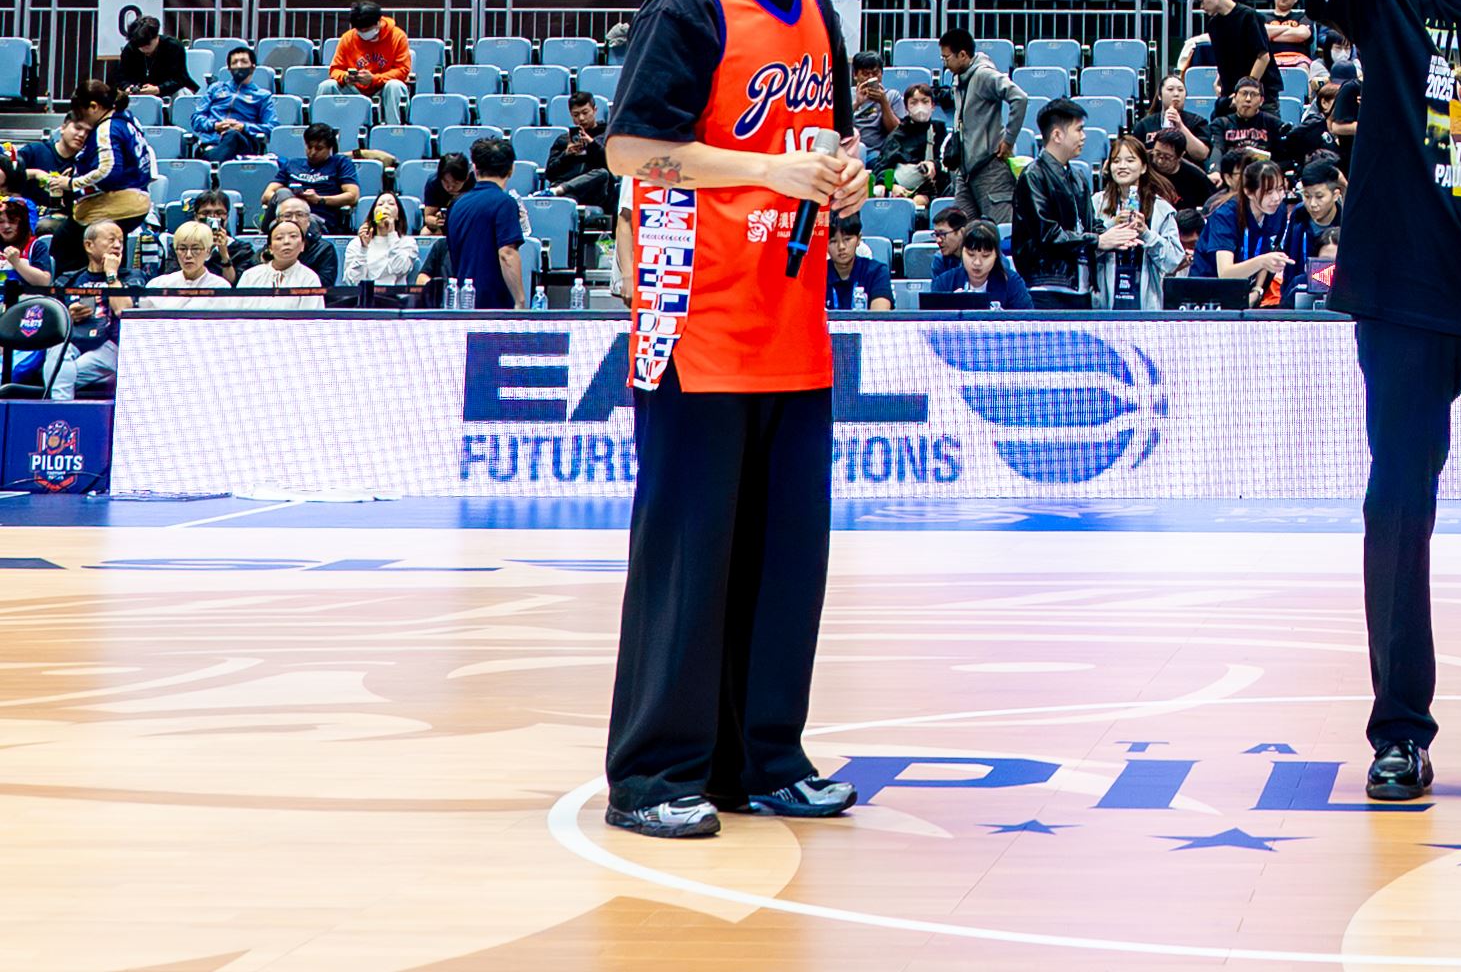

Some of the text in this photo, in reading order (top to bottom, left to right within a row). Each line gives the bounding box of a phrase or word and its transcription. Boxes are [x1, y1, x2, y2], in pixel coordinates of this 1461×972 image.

[733, 52, 834, 140] Pilots
[1425, 73, 1456, 102] 2025
[32, 455, 83, 471] PILOTS
[460, 434, 638, 482] FUTURE
